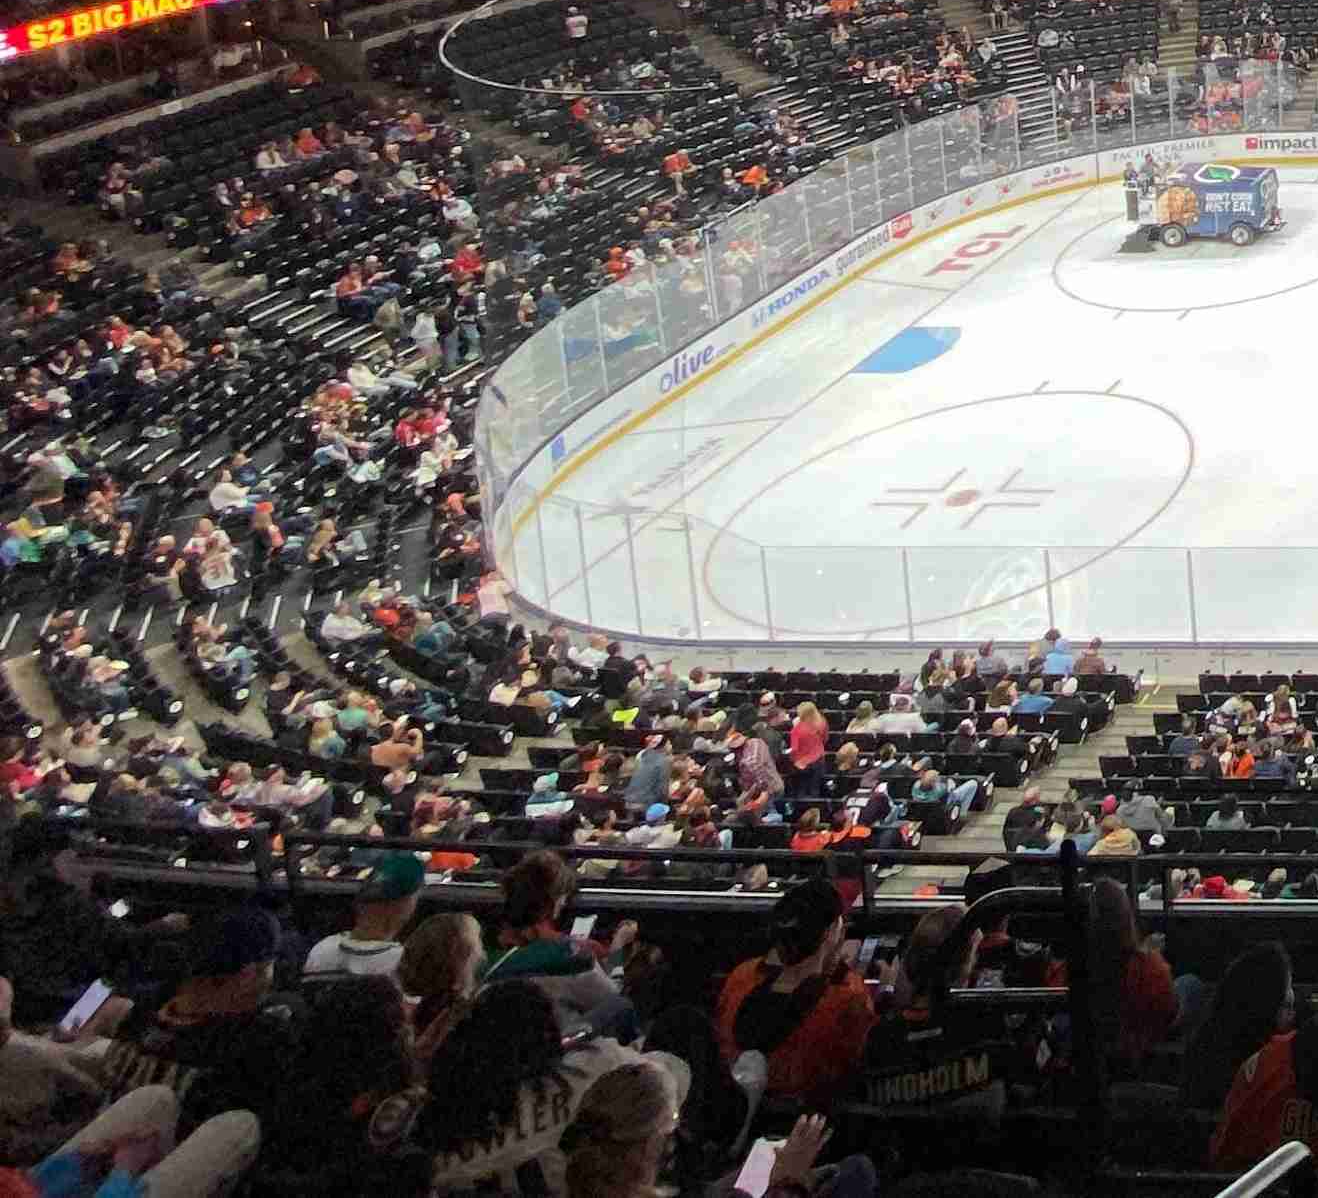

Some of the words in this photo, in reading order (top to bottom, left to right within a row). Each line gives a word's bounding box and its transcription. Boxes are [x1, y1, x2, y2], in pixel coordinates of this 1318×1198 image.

[72, 3, 126, 35] BIG
[1258, 136, 1318, 151] impact
[920, 222, 1026, 278] TCL
[767, 268, 832, 316] HONDA
[659, 344, 715, 394] olive
